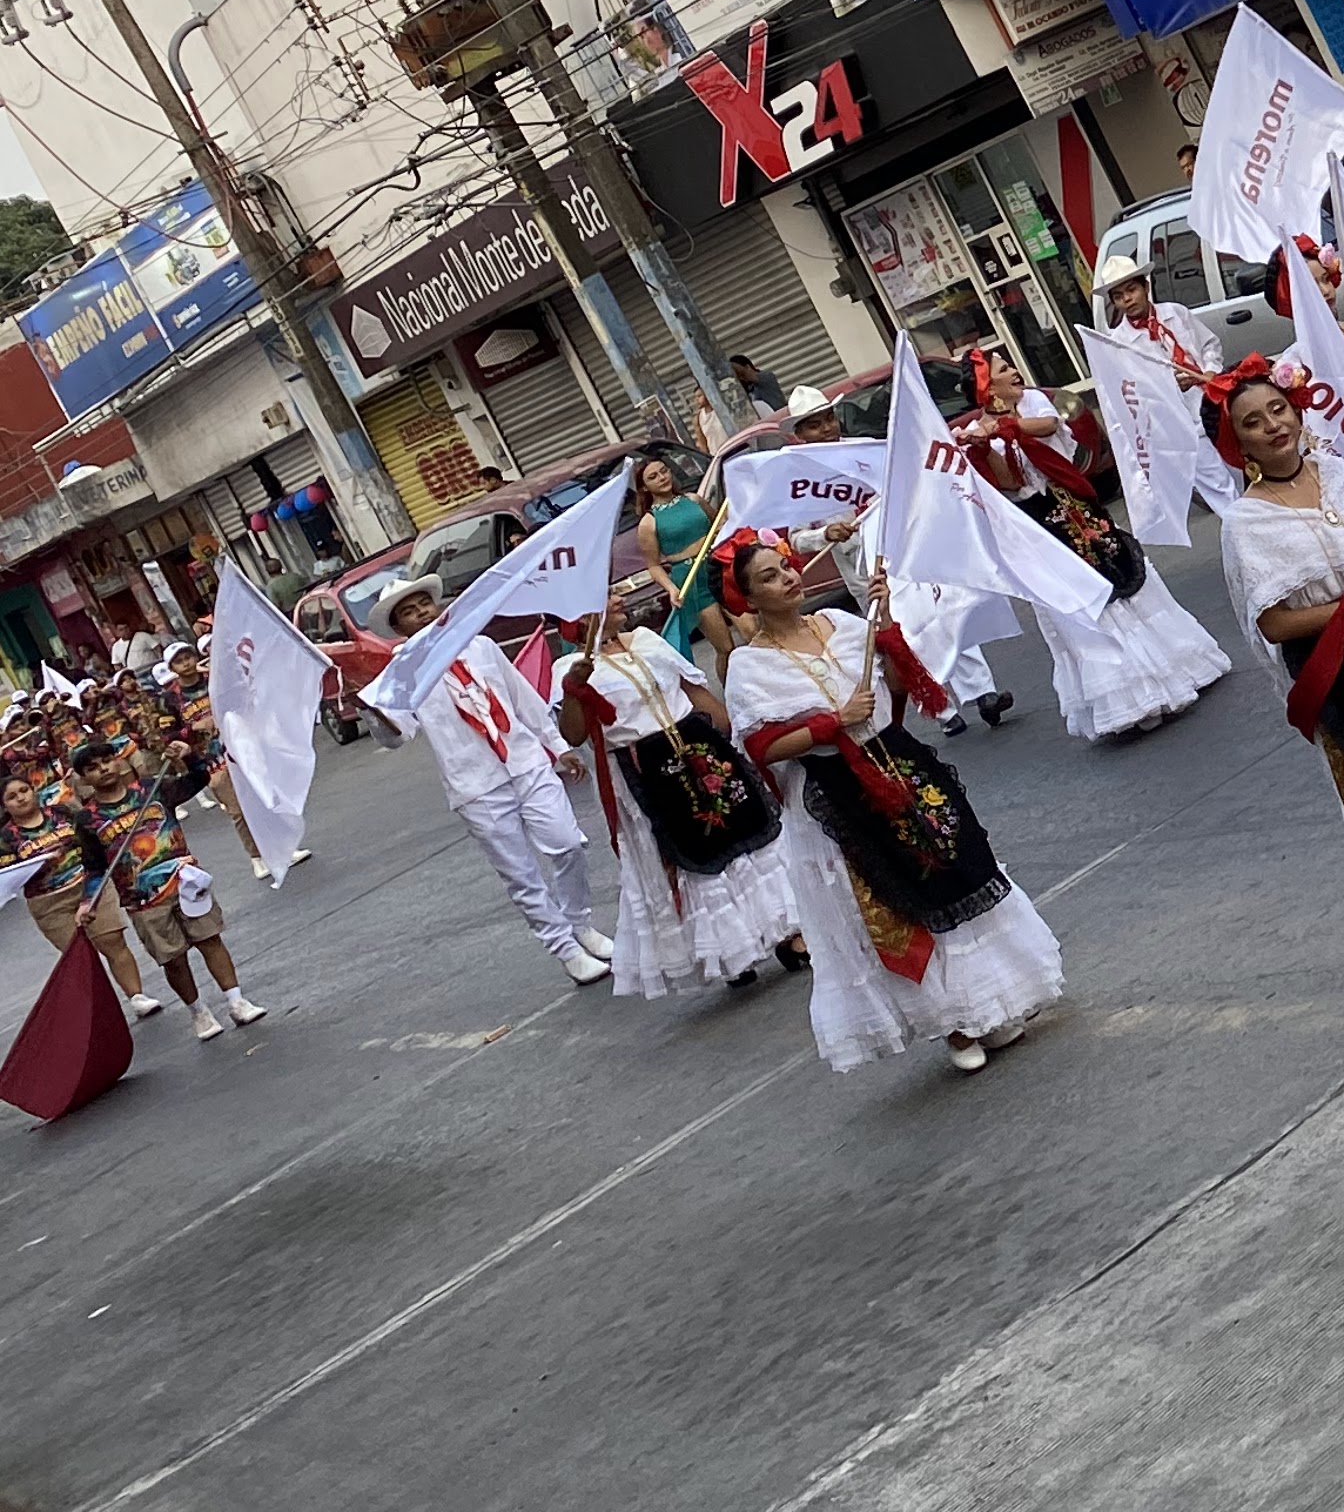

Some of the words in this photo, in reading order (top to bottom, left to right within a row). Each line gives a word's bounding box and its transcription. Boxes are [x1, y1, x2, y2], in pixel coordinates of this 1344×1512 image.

[45, 304, 108, 371] EMPEÑO
[97, 280, 145, 333] FÁCIL
[375, 251, 470, 343] Nacional
[447, 231, 526, 304] Monte
[511, 208, 553, 271] de
